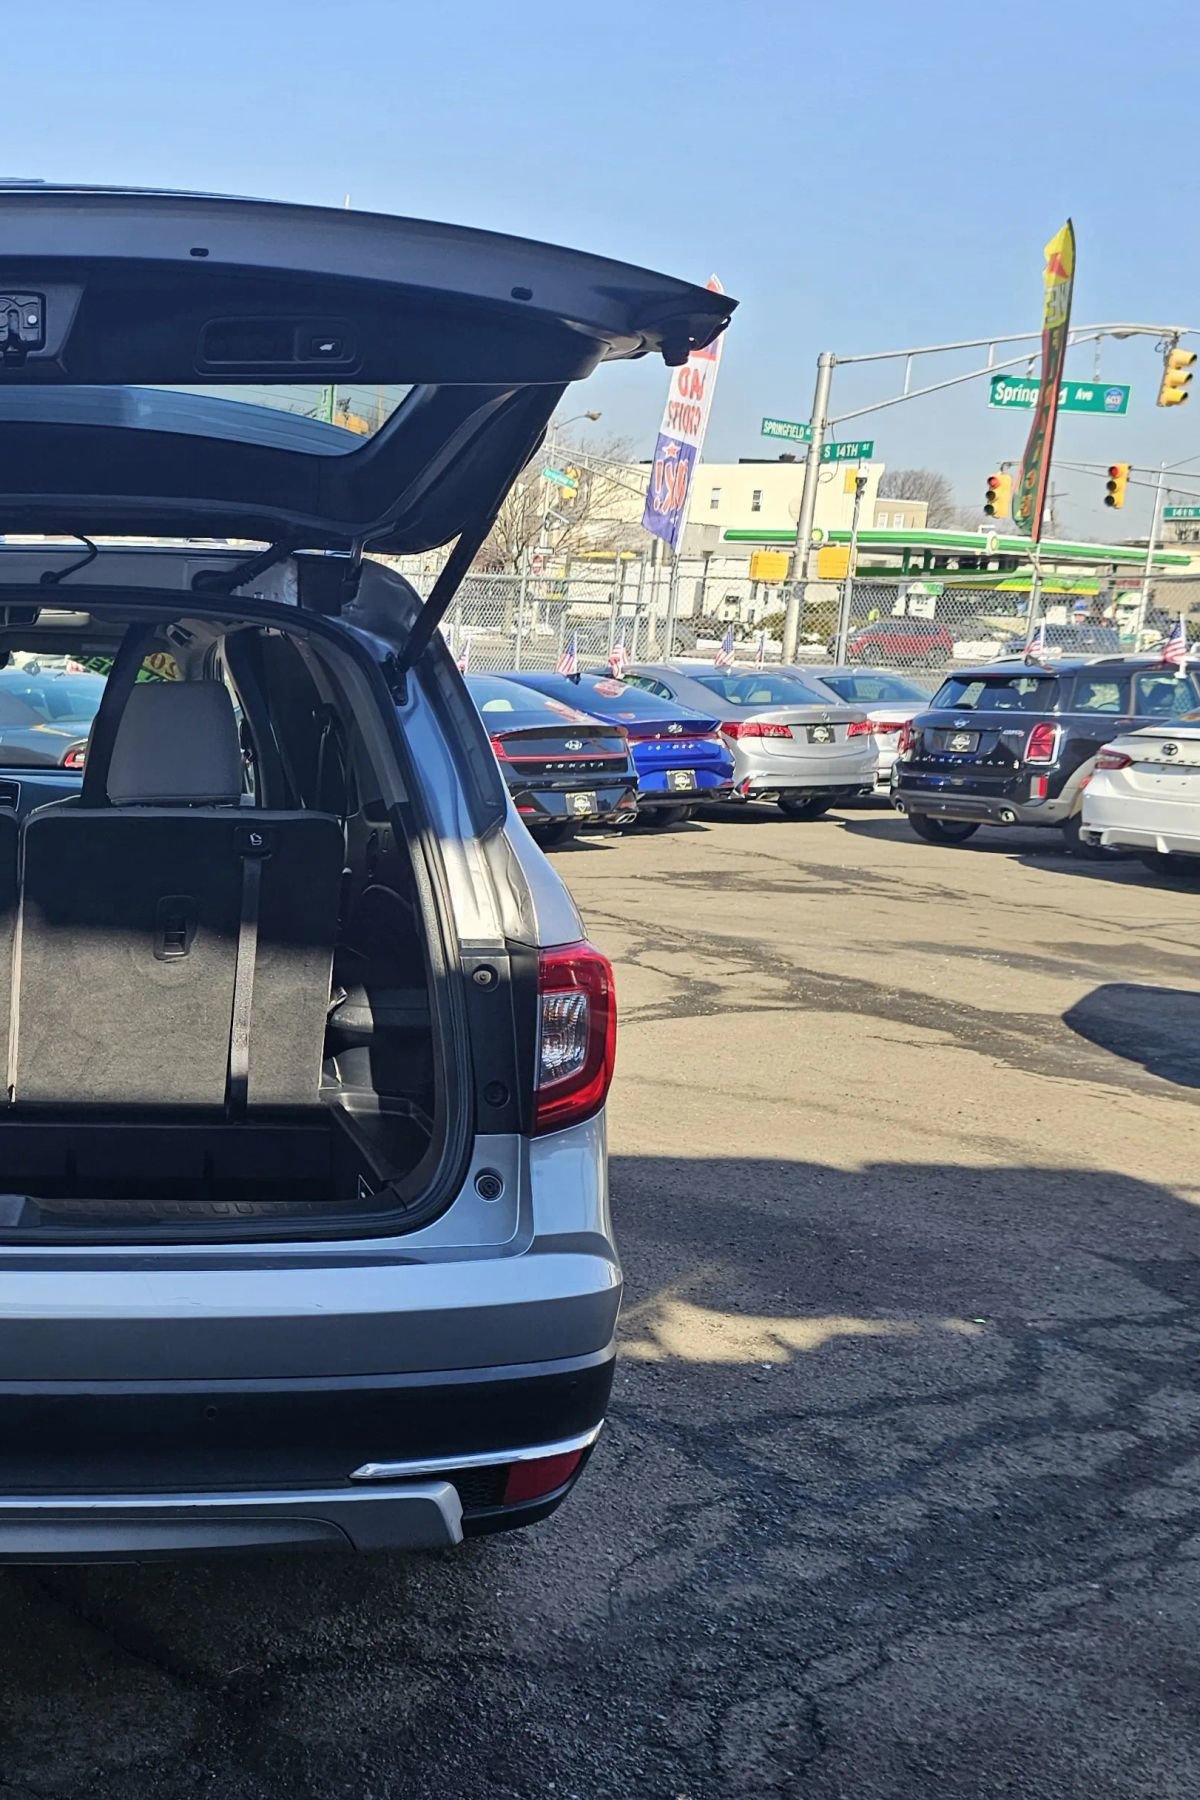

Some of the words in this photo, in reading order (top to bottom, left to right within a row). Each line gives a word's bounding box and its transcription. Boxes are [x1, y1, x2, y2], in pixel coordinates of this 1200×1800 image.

[995, 382, 1068, 407] Springd
[1075, 388, 1094, 401] Ave
[763, 420, 804, 438] SPRINGFIELD
[824, 446, 831, 458] S
[836, 444, 858, 457] 14TH
